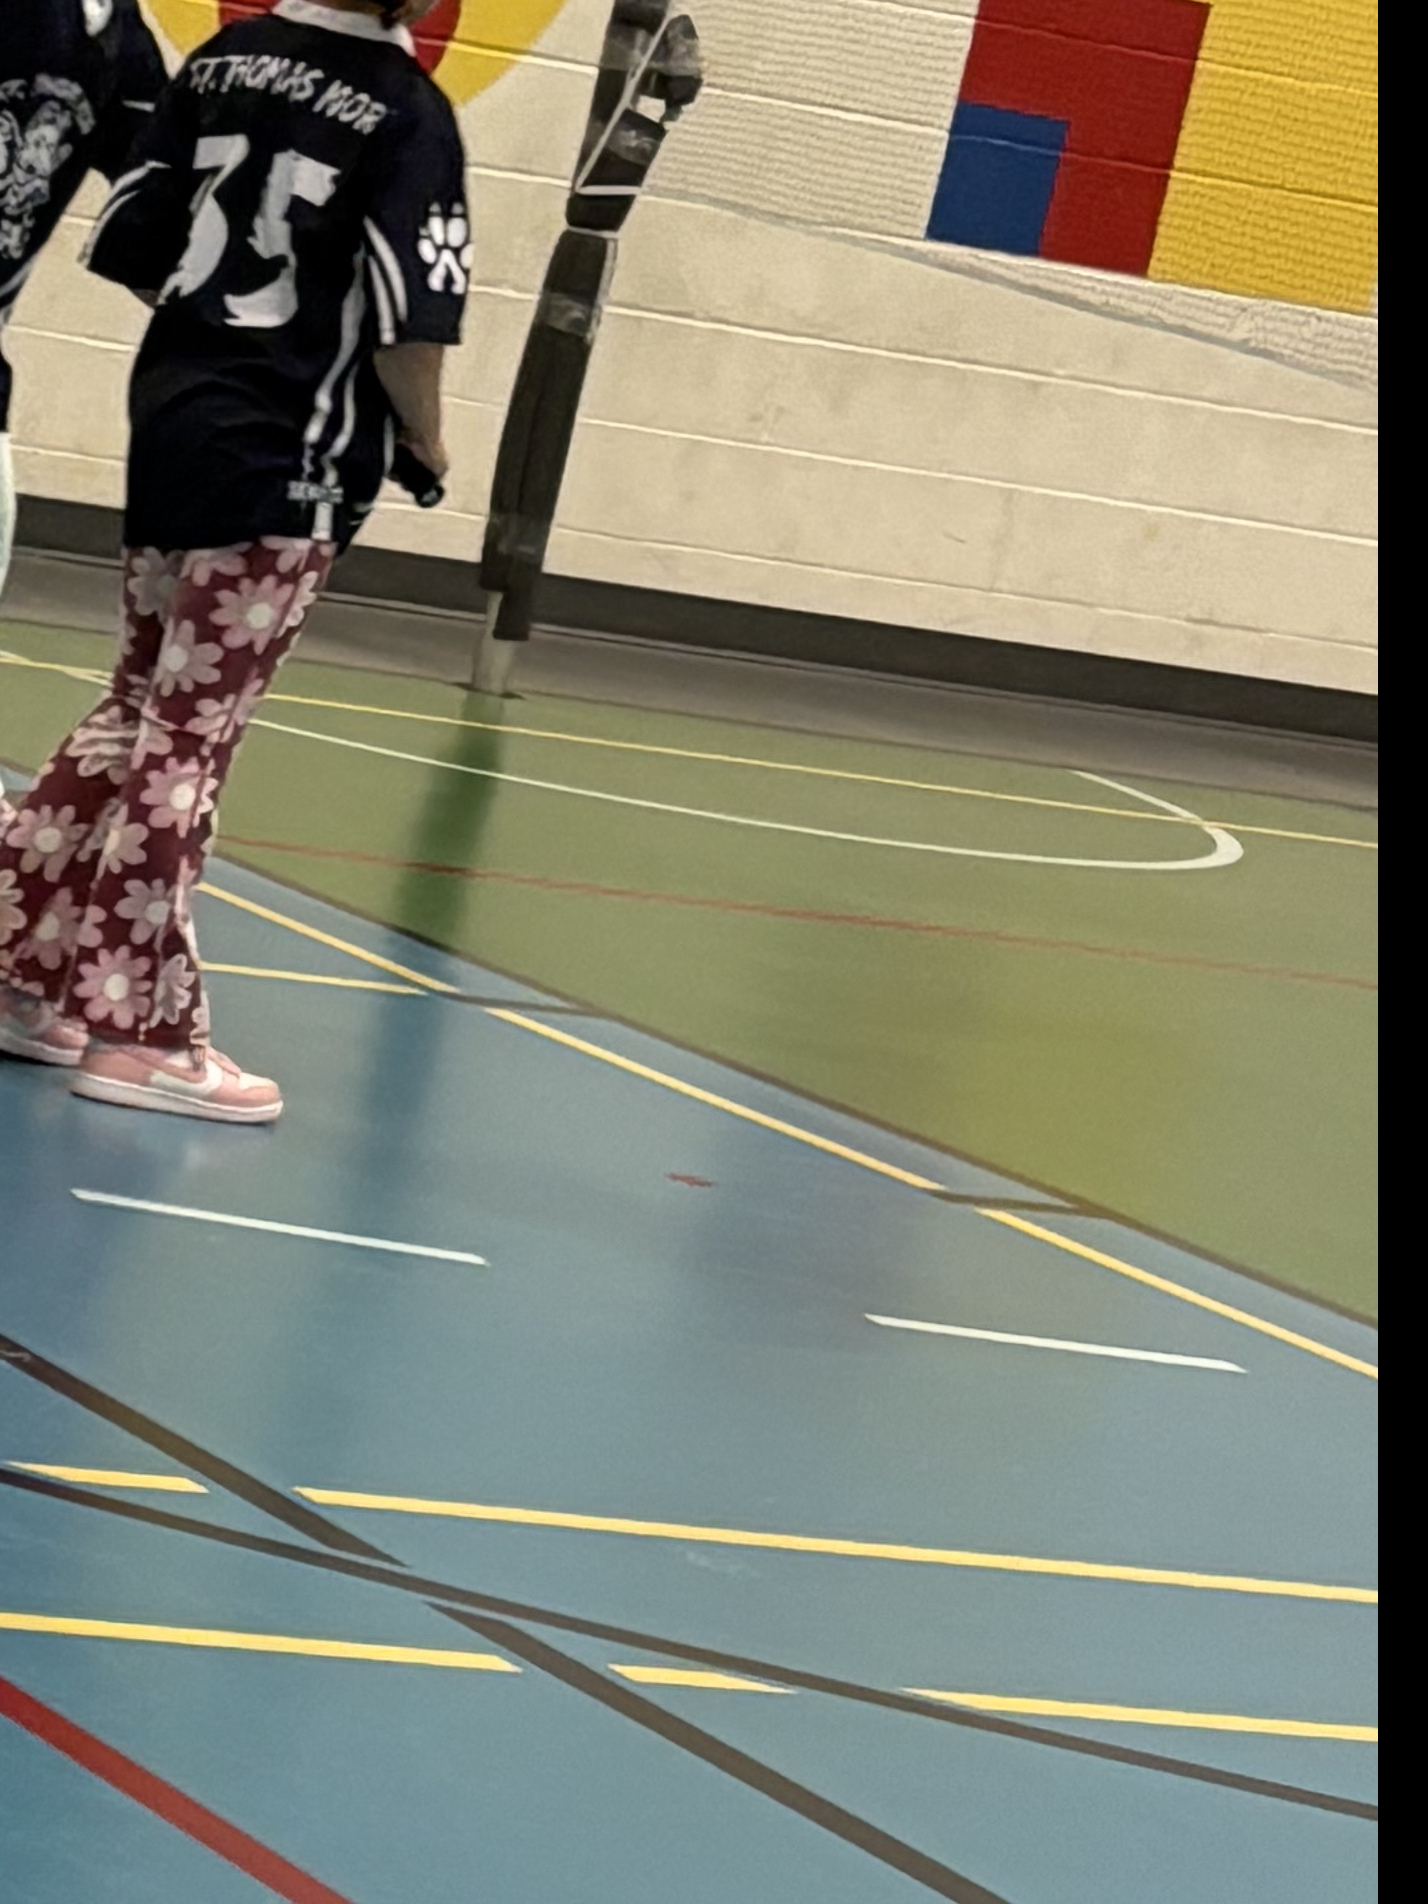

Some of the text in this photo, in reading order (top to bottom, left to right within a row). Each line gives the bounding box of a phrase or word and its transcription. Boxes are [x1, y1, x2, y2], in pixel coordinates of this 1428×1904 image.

[220, 54, 325, 102] THOMAS
[312, 79, 390, 135] MOR
[157, 133, 341, 328] 35
